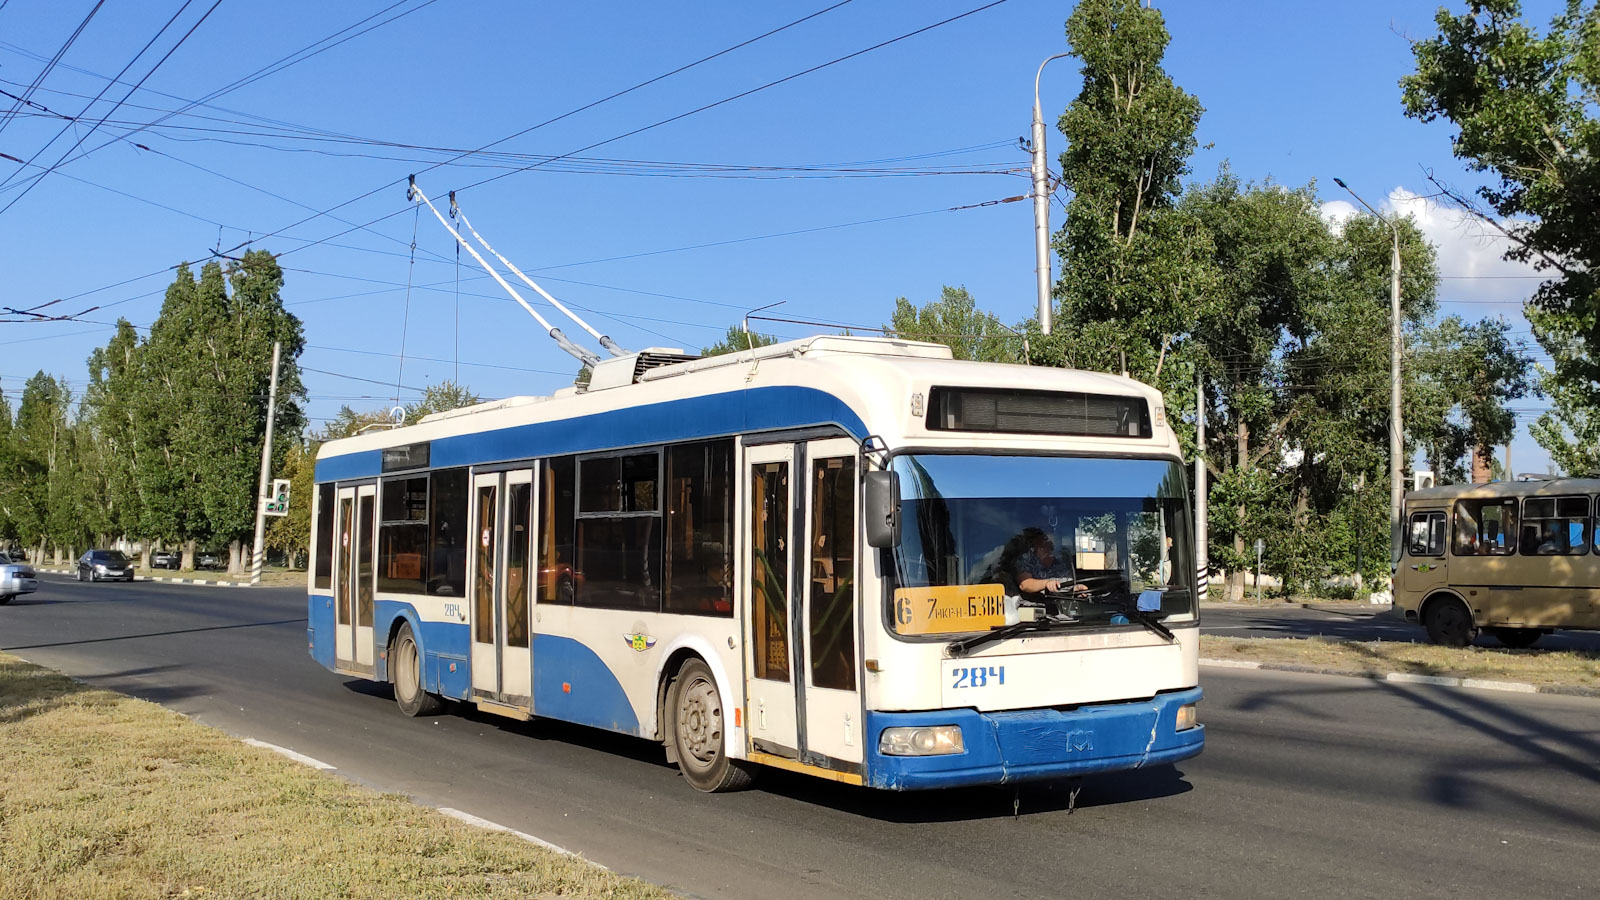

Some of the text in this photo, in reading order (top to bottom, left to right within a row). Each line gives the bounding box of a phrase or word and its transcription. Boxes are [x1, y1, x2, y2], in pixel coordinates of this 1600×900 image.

[444, 603, 460, 617] 284
[896, 597, 913, 625] 6
[952, 666, 1005, 689] 284
